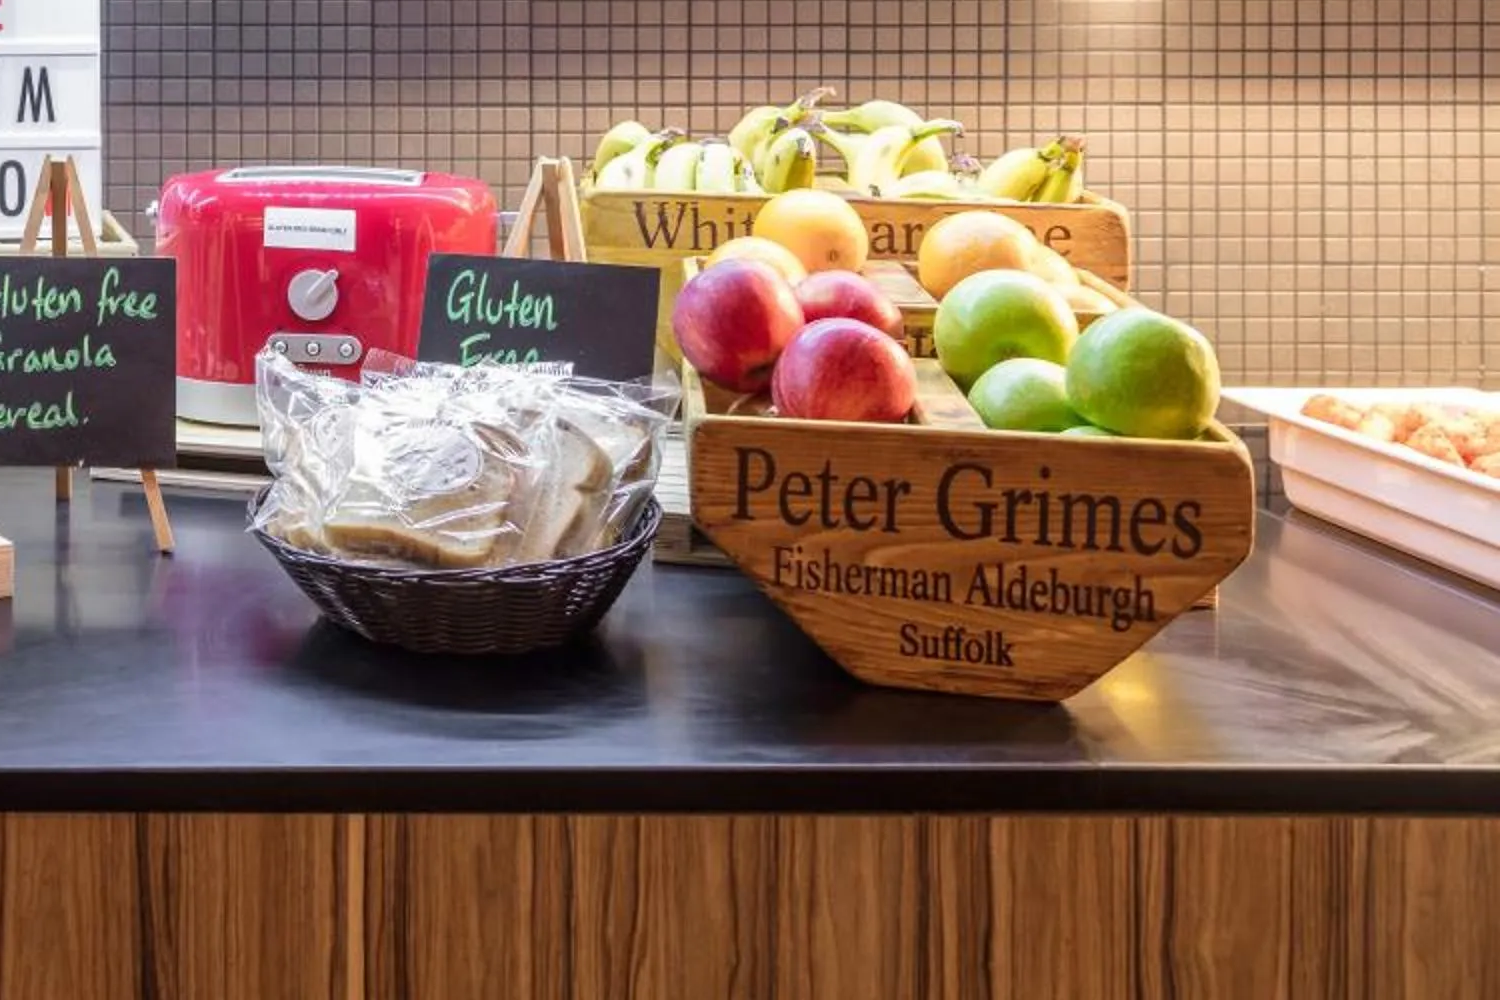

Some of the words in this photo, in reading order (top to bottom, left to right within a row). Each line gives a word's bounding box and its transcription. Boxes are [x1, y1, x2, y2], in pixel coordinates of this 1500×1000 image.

[633, 200, 755, 251] Whit
[870, 222, 924, 255] ar
[97, 266, 159, 327] free
[446, 268, 559, 332] Gluten
[731, 445, 911, 533] Peter
[936, 461, 1204, 559] Grimes
[772, 545, 953, 604] Fisherman
[964, 562, 1156, 633] Aldeburgh
[899, 622, 1015, 668] Suffolk
